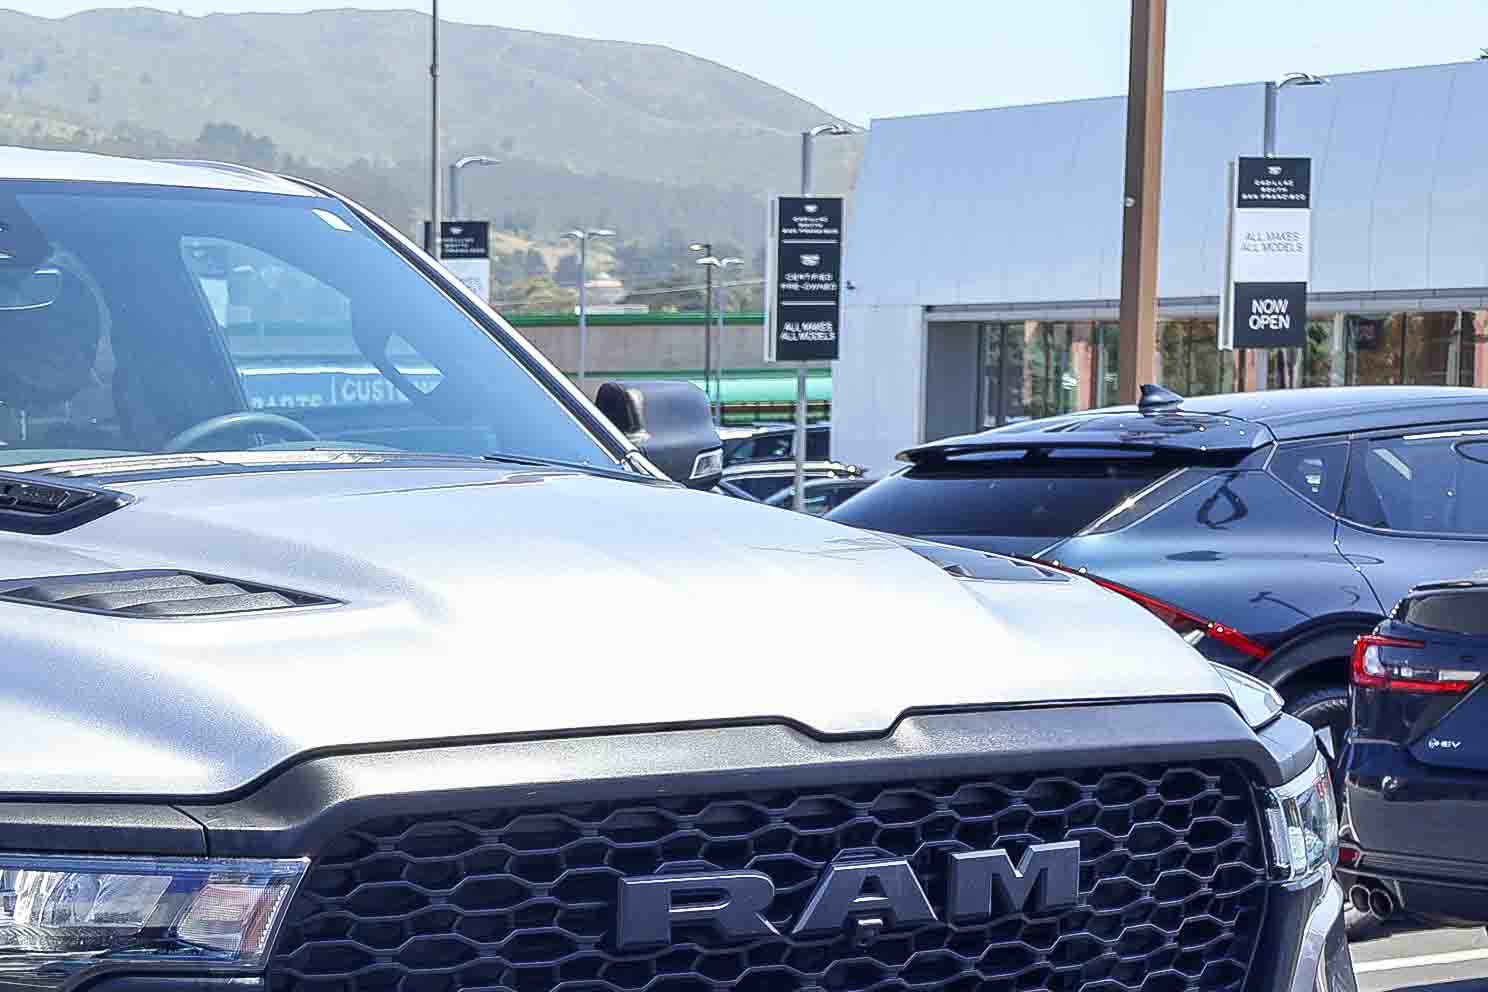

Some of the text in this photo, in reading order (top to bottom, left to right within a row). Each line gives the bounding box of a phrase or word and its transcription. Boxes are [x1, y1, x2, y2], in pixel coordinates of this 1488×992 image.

[1252, 299, 1288, 314] NOW
[1248, 315, 1290, 330] OPEN
[617, 840, 1081, 948] RAM
